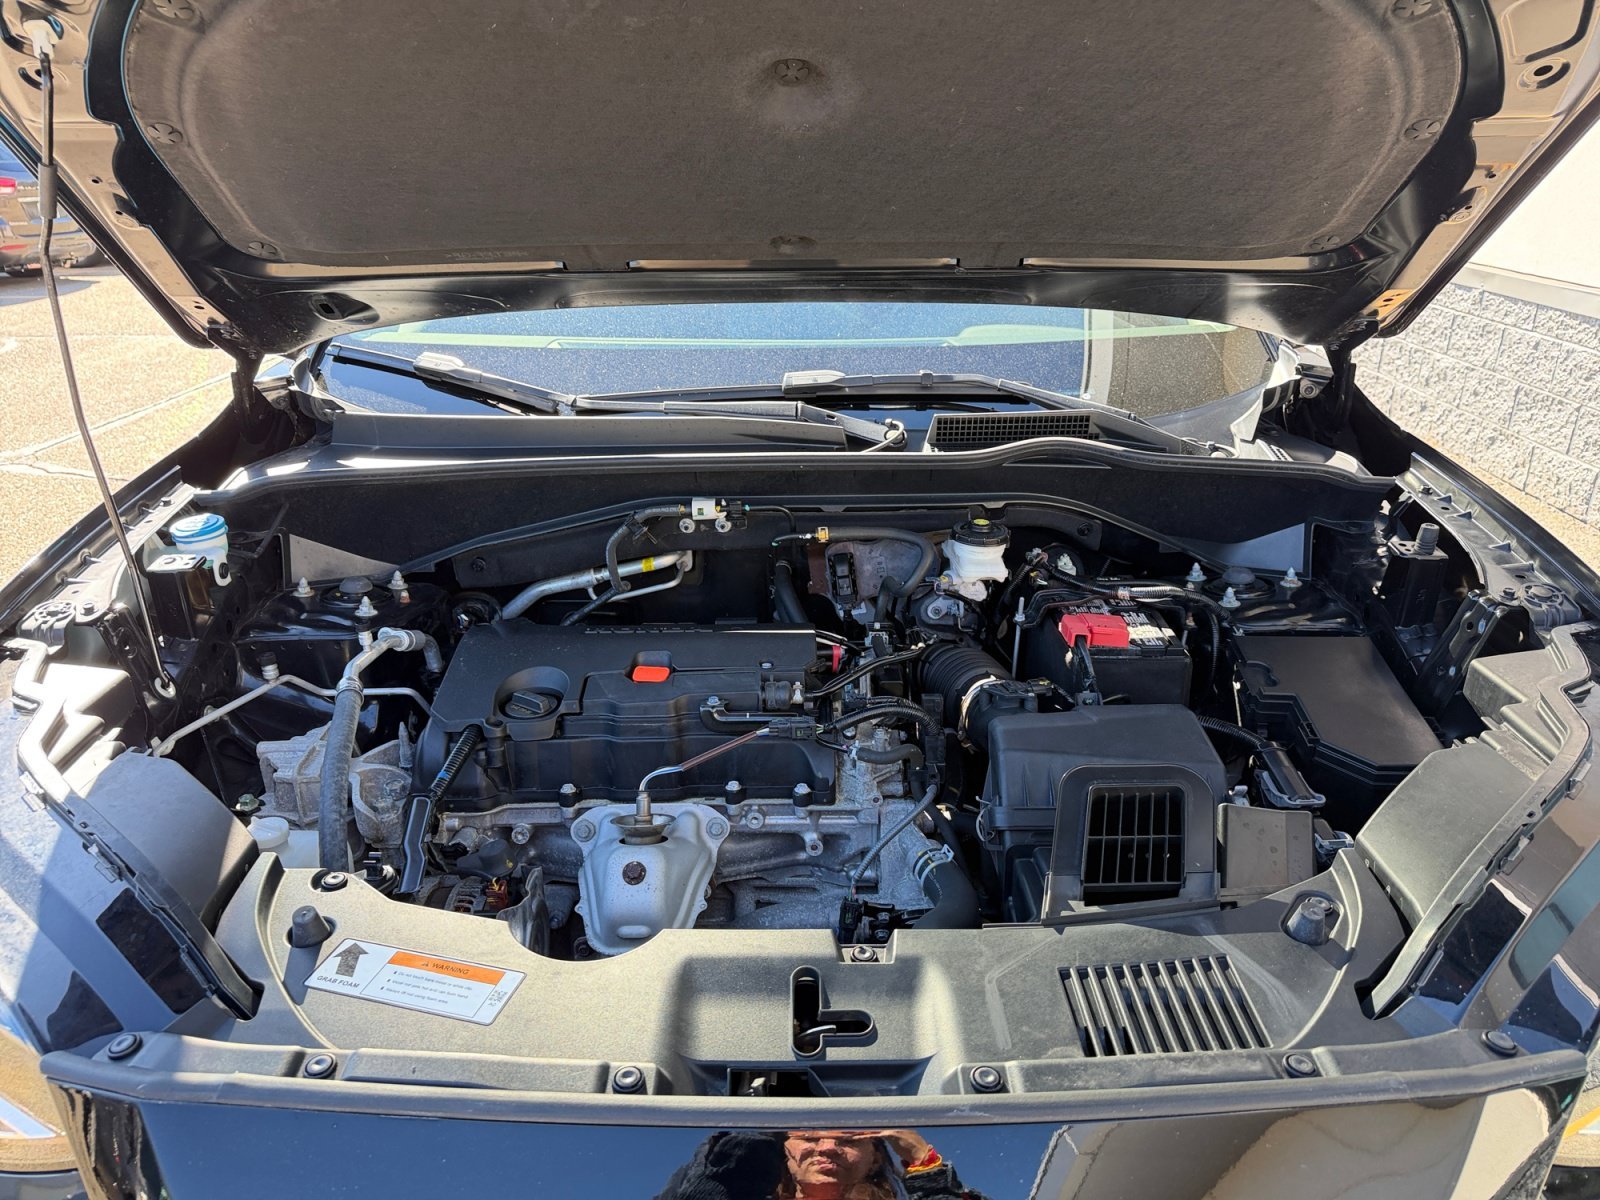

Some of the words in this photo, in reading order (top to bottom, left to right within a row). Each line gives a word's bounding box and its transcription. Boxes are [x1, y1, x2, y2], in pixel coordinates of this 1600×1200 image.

[432, 963, 470, 975] WARNING
[316, 975, 337, 984] GRAB
[337, 980, 360, 989] FOAM
